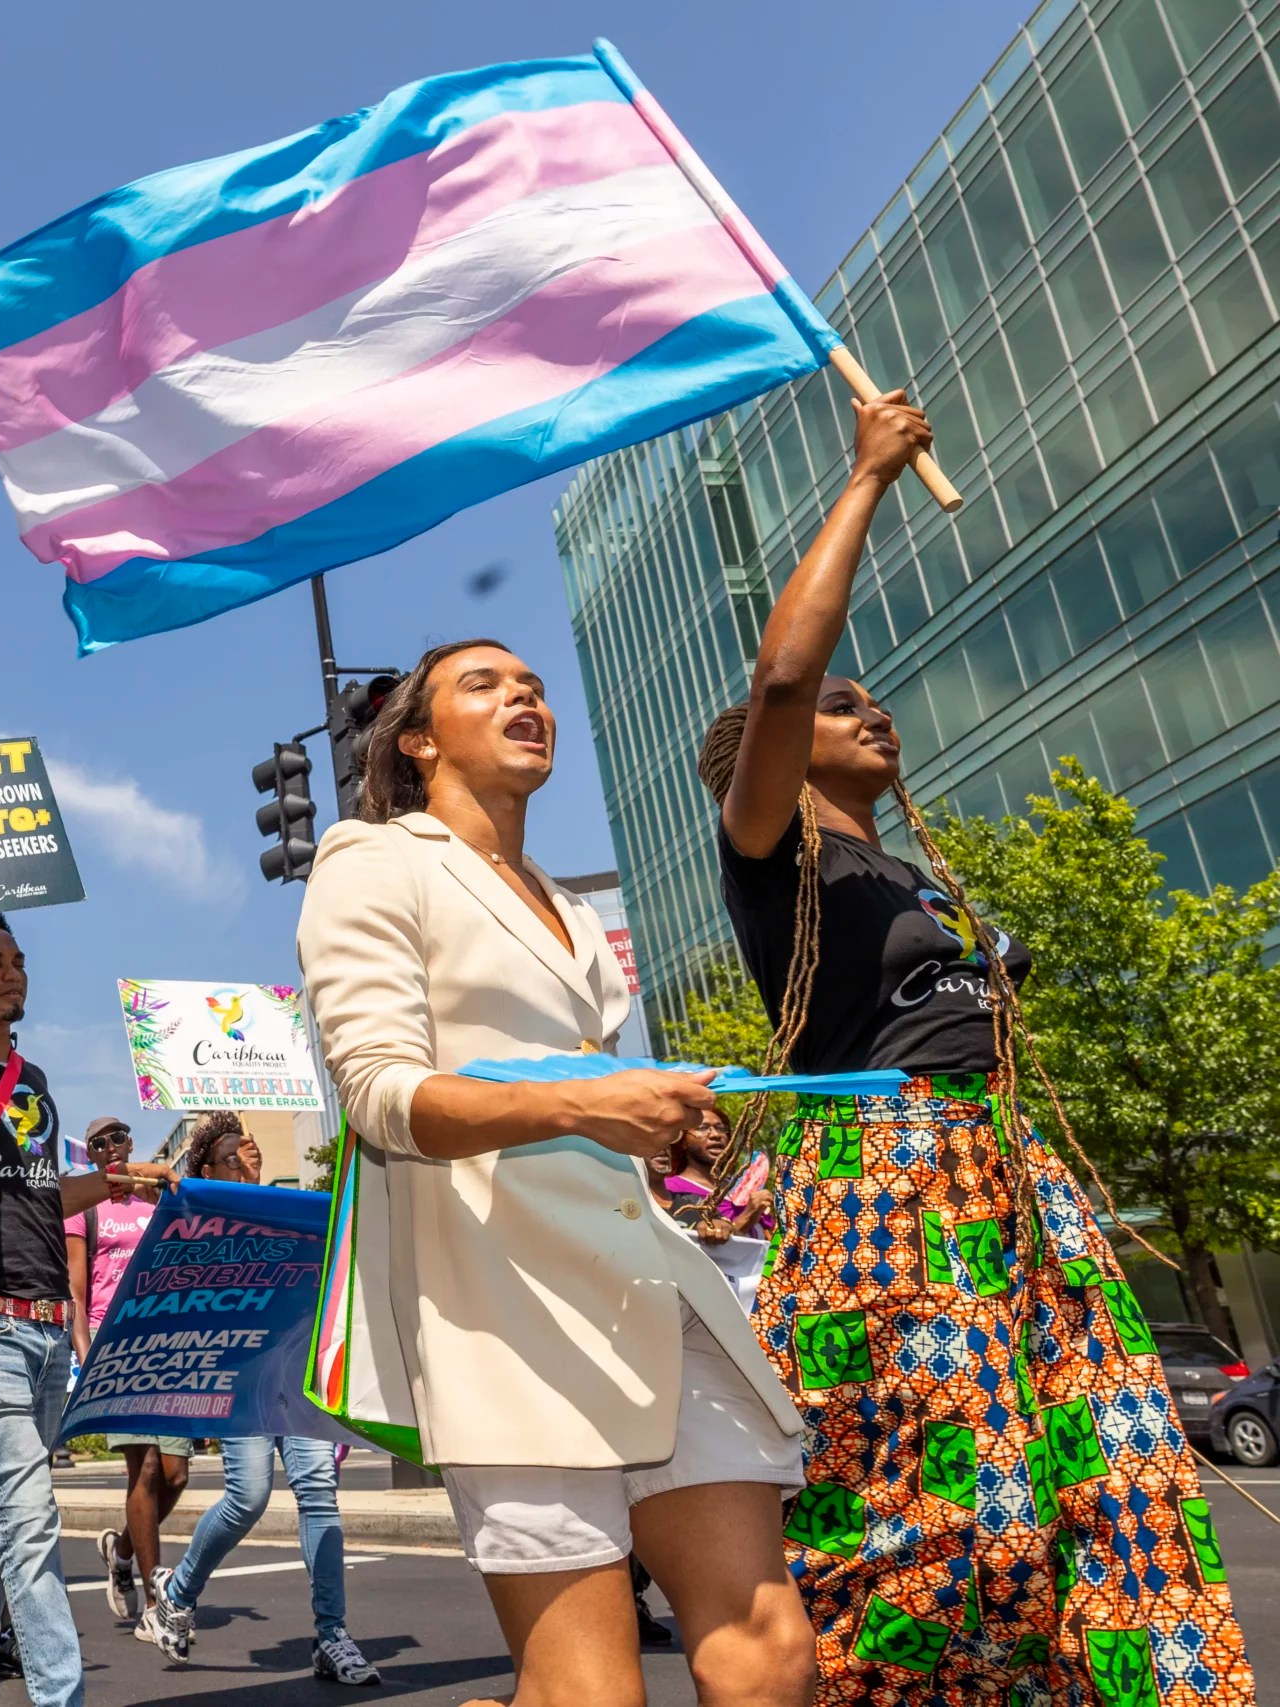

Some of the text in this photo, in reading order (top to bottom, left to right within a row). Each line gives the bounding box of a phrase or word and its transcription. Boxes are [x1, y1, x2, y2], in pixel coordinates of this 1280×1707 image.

[193, 1039, 286, 1066] Caribbean
[176, 1076, 218, 1094] LIVE
[181, 1096, 319, 1106] WE WILL NOT BE ERASED
[99, 1218, 138, 1238] Love
[152, 1237, 298, 1268] TRANS
[113, 1288, 276, 1325] MARCH
[93, 1329, 269, 1365] ILLUMINATE
[82, 1350, 224, 1388] EDUCATE
[71, 1371, 239, 1409] ADVOCATE
[109, 1397, 129, 1414] WE
[128, 1395, 154, 1413] CAN
[154, 1395, 169, 1413] BE
[170, 1394, 210, 1415] PROUD
[212, 1395, 232, 1415] OF!
